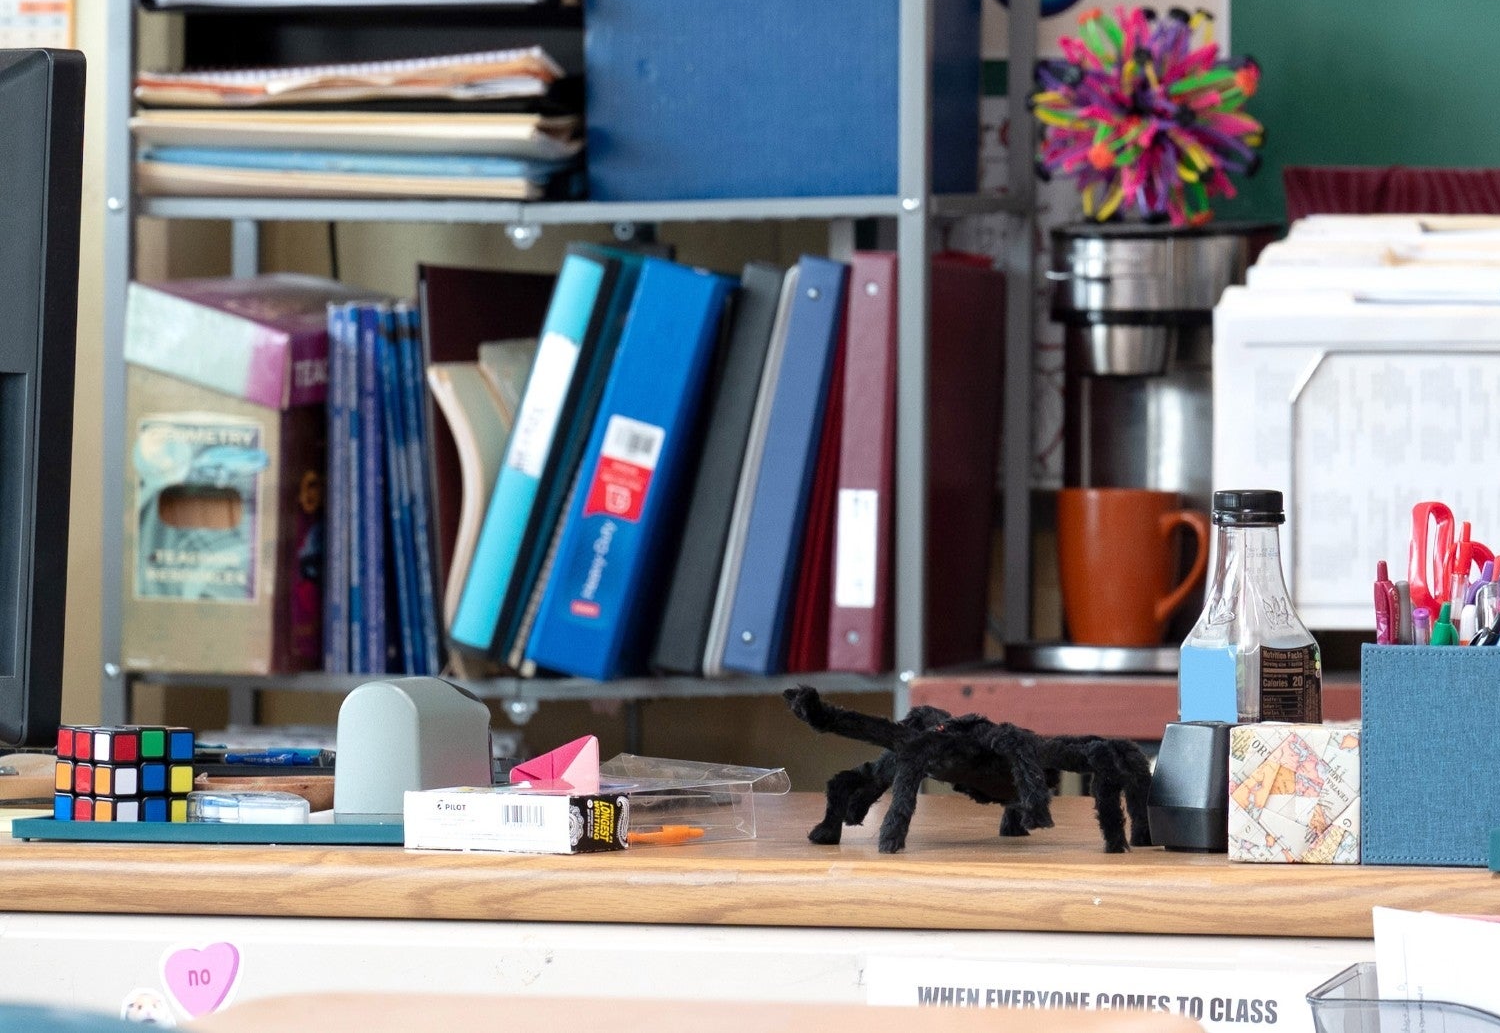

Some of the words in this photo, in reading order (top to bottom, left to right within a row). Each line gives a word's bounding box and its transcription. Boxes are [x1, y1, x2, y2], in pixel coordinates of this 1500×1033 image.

[295, 360, 328, 388] TEA
[1262, 649, 1287, 660] Nutrition
[1287, 650, 1303, 659] Facts
[1263, 678, 1288, 687] Calories
[1292, 675, 1303, 687] 20
[445, 803, 466, 811] PILOT
[593, 800, 601, 840] WRITING
[600, 801, 611, 842] LONGEST
[188, 968, 211, 986] no
[917, 986, 979, 1008] WHEN
[986, 989, 1090, 1011] EVERYONE
[1096, 992, 1171, 1015] COMES
[1177, 996, 1204, 1021] TO
[1209, 998, 1278, 1024] CLASS
